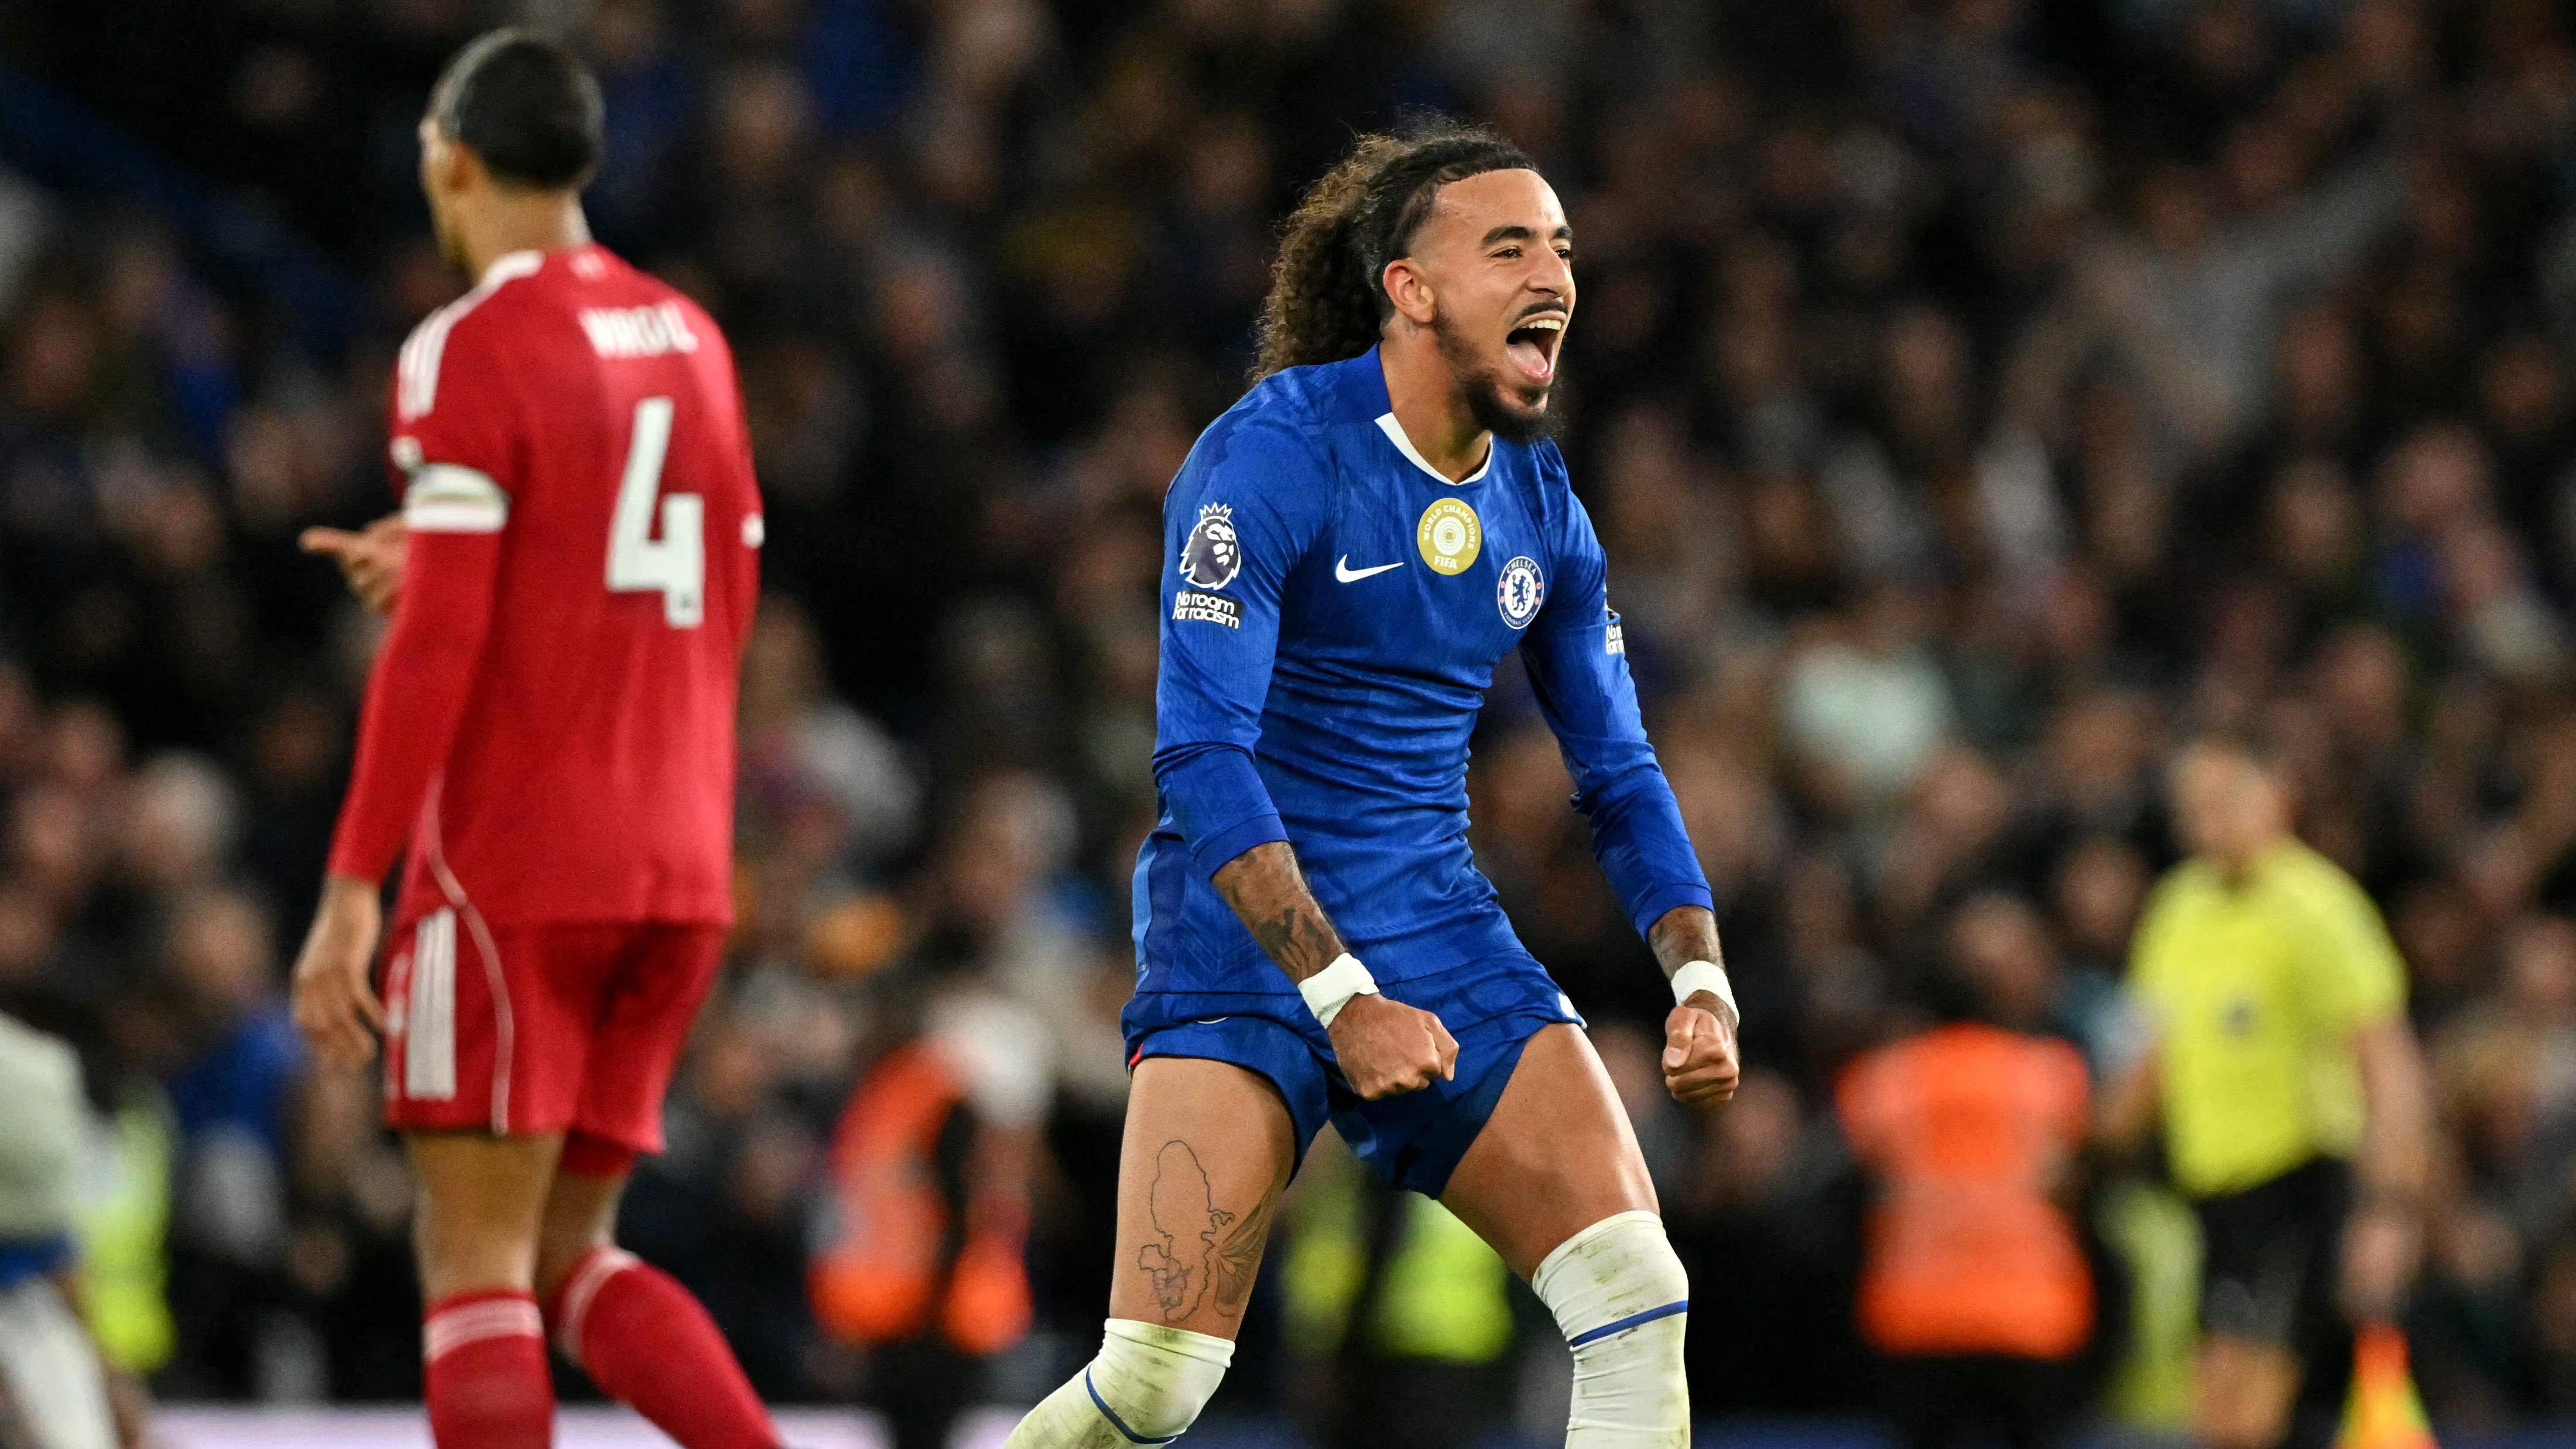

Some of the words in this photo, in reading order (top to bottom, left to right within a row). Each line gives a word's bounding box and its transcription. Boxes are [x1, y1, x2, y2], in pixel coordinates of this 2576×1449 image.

[605, 396, 705, 629] 4
[1424, 508, 1442, 541] WORLD
[1444, 505, 1476, 549] CHAMPIONS
[1434, 556, 1457, 570] FIFA
[1506, 560, 1536, 575] CHELSEA
[1176, 592, 1190, 607] No
[1191, 594, 1235, 615] room
[1173, 605, 1189, 619] for
[1189, 607, 1239, 629] racism
